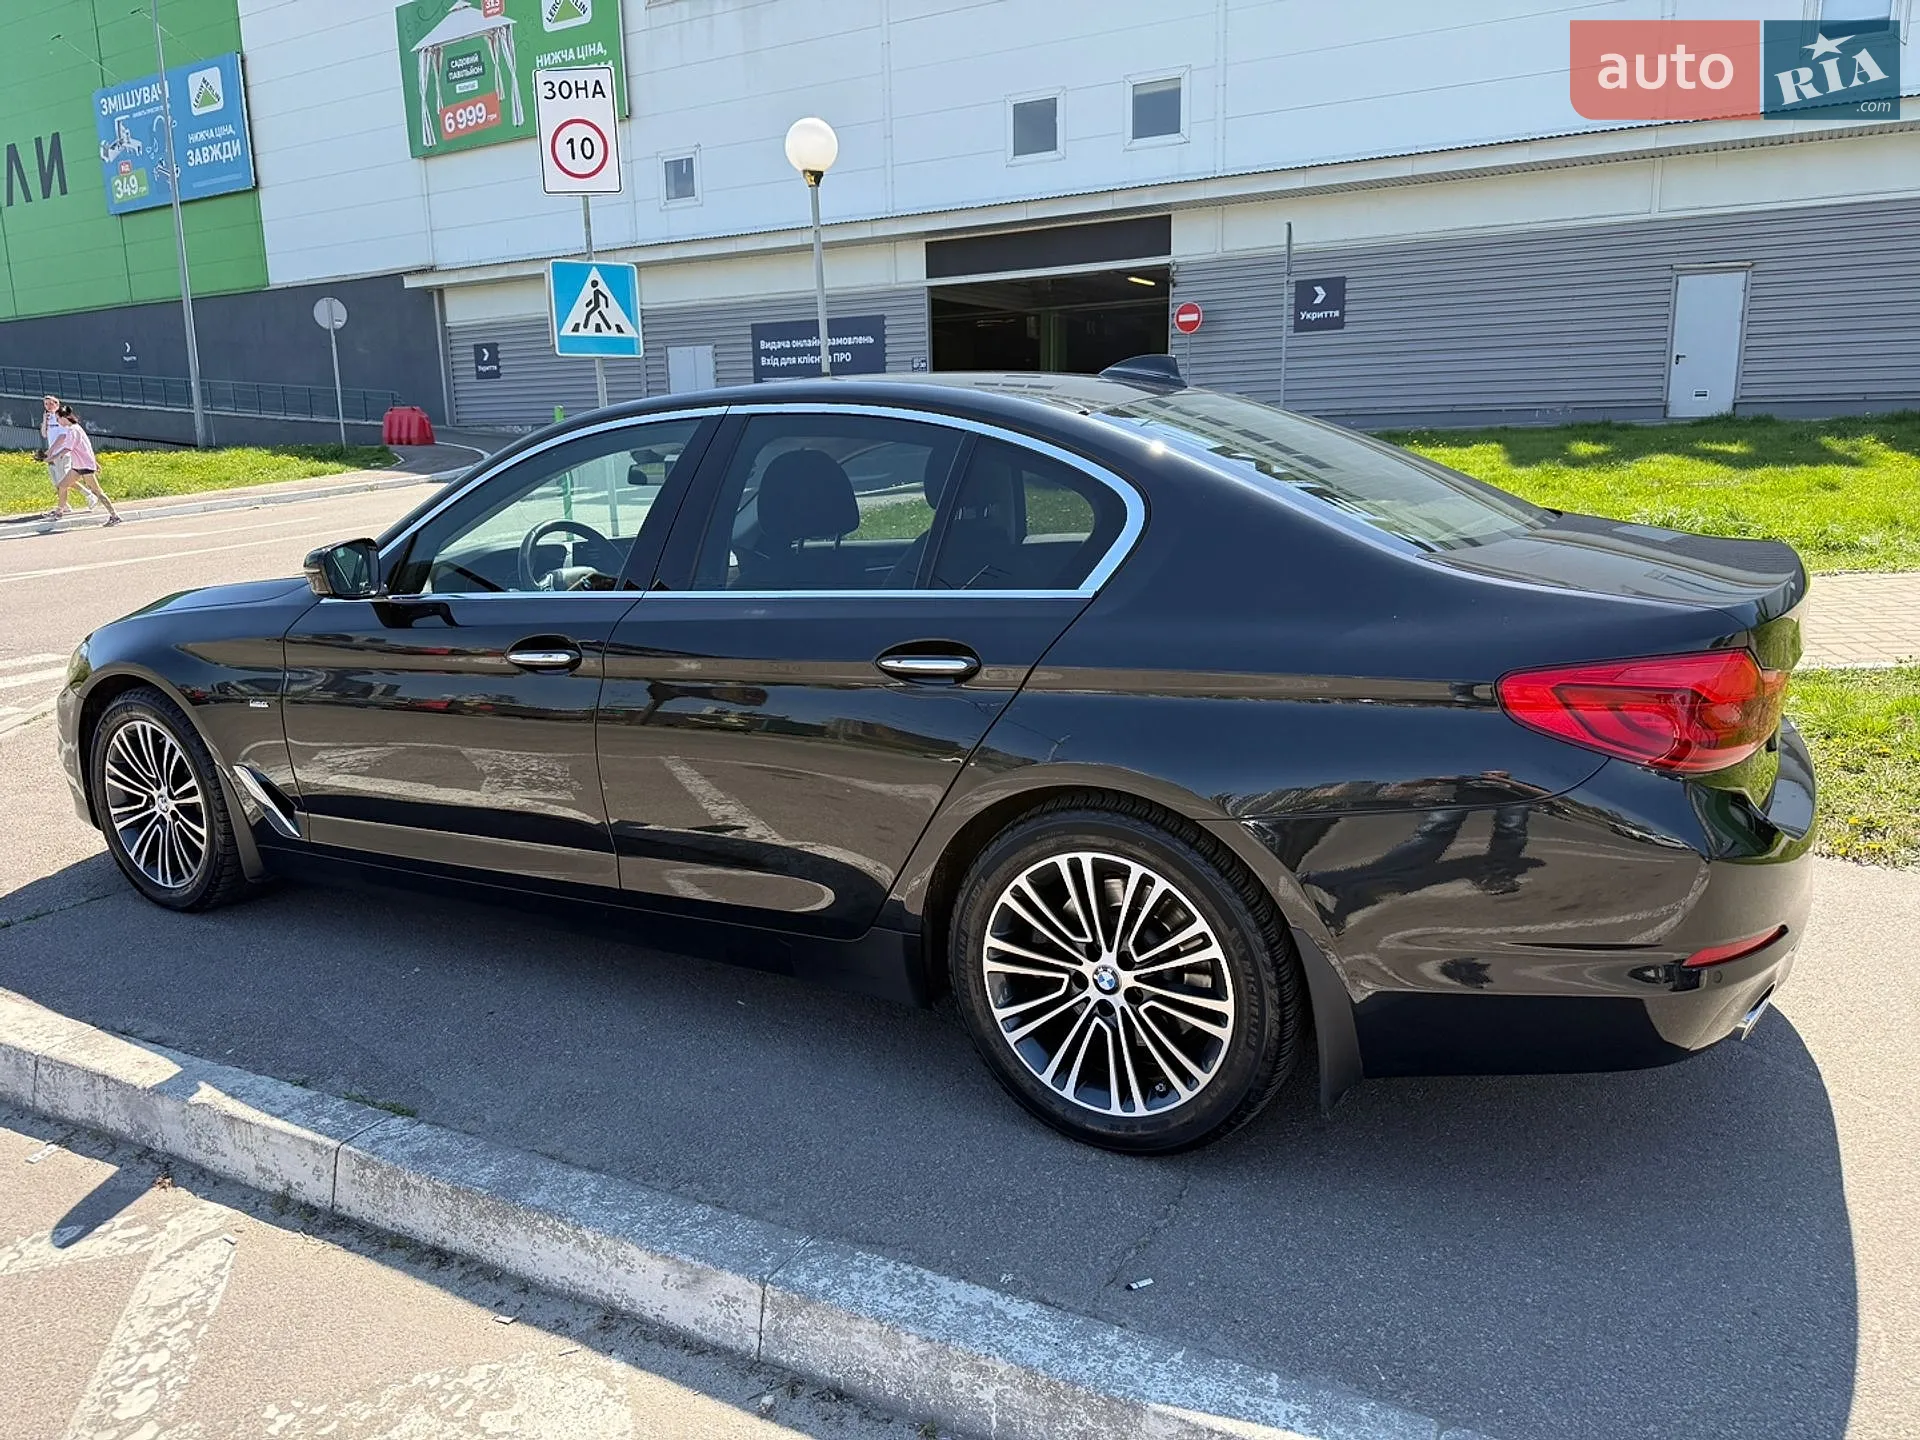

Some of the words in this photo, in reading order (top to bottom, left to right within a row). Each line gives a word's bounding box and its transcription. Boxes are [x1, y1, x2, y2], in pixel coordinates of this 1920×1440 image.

[536, 47, 575, 68] НИЖЧА
[576, 41, 607, 61] ЦІНА,
[543, 80, 606, 100] ЗОНА
[187, 138, 241, 167] ЗАВЖДИ
[566, 137, 595, 160] 10
[114, 174, 138, 199] 349
[1300, 310, 1340, 321] Укриття
[760, 339, 791, 351] Видача
[761, 355, 779, 367] Вхід
[833, 352, 852, 363] ПРО
